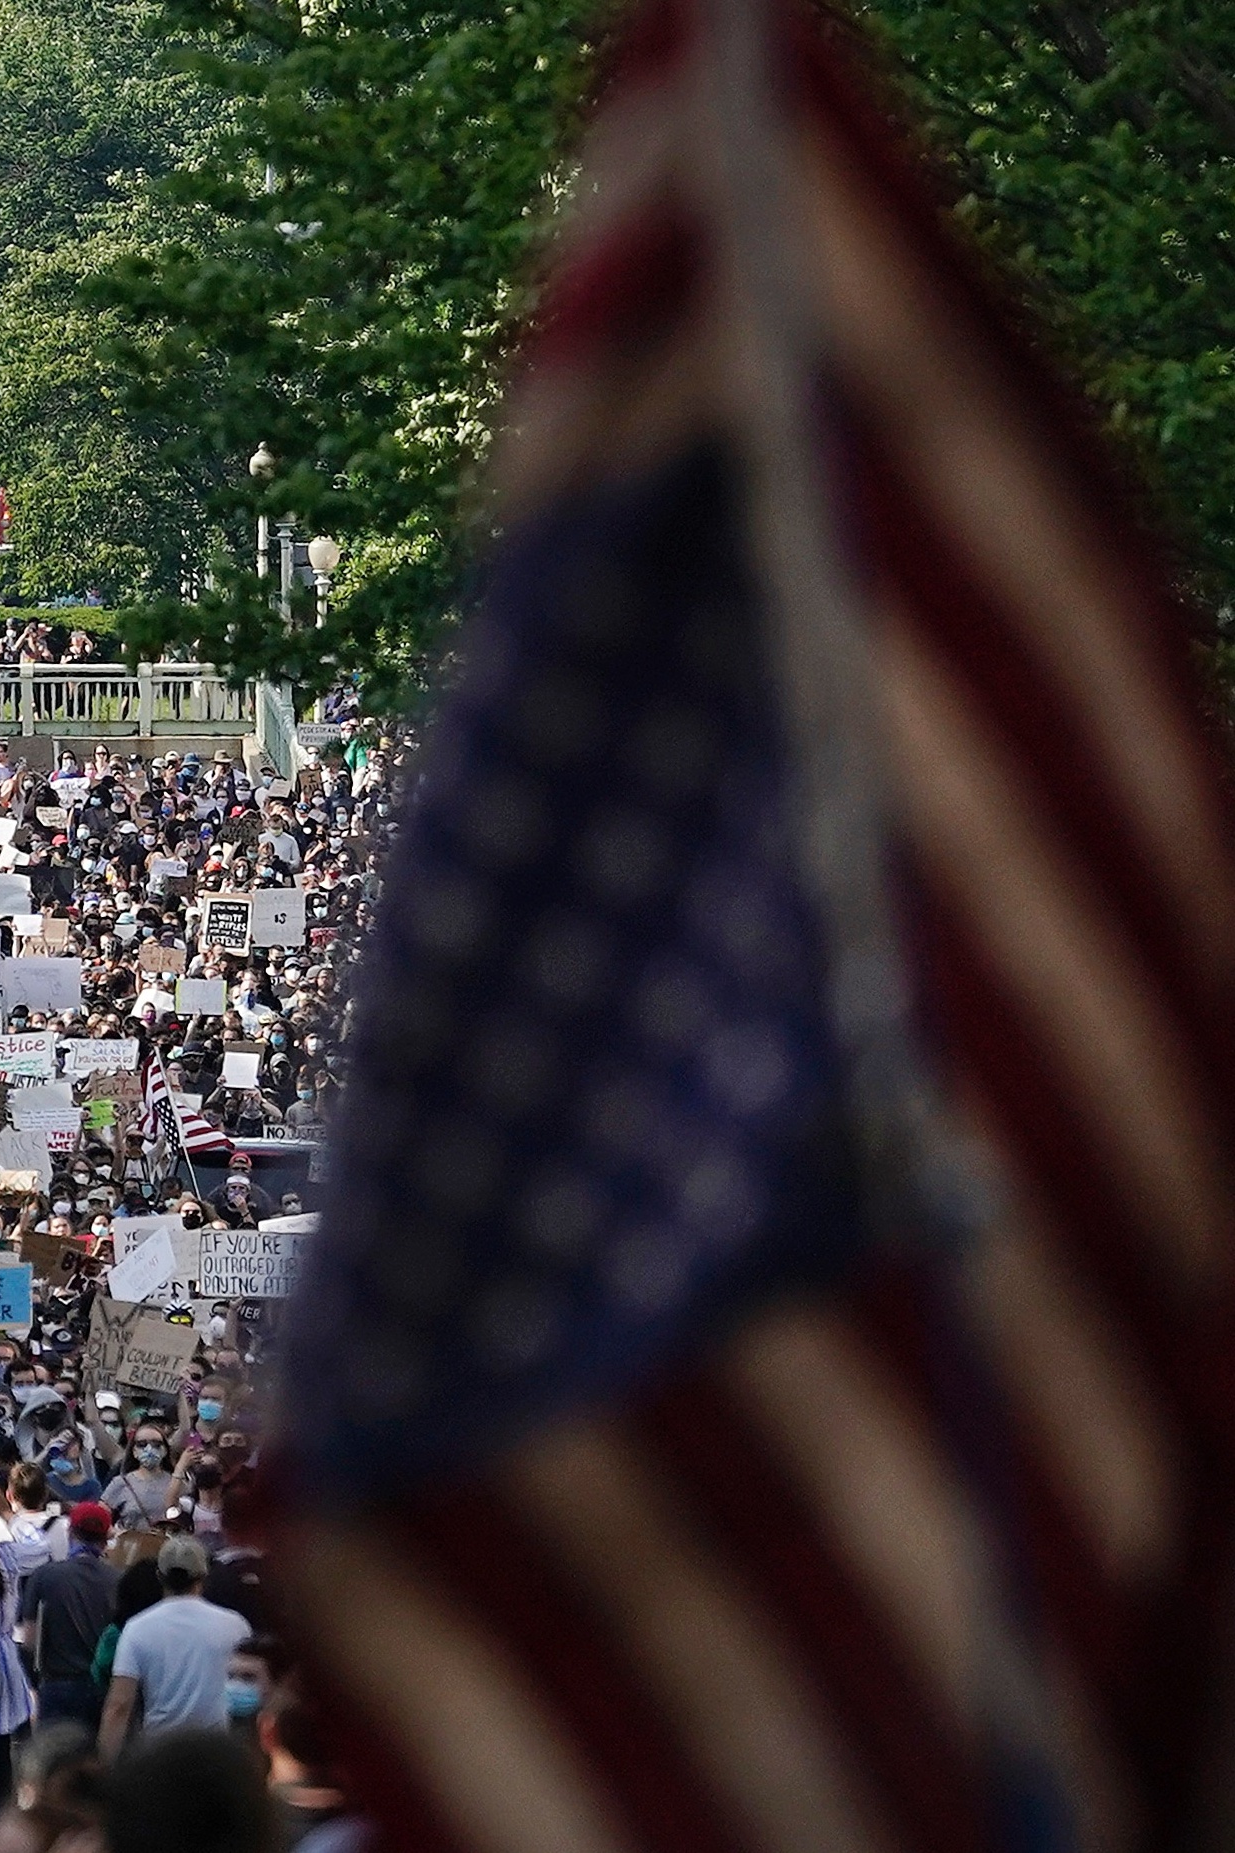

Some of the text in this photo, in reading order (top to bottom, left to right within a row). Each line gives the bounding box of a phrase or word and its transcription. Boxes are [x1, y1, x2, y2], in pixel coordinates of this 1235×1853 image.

[52, 1131, 78, 1140] THEI
[267, 1127, 285, 1140] NO
[202, 1233, 222, 1252] IF
[226, 1233, 282, 1255] YOU'RE
[203, 1256, 275, 1276] OUTRAGED
[204, 1276, 259, 1297] PAYING
